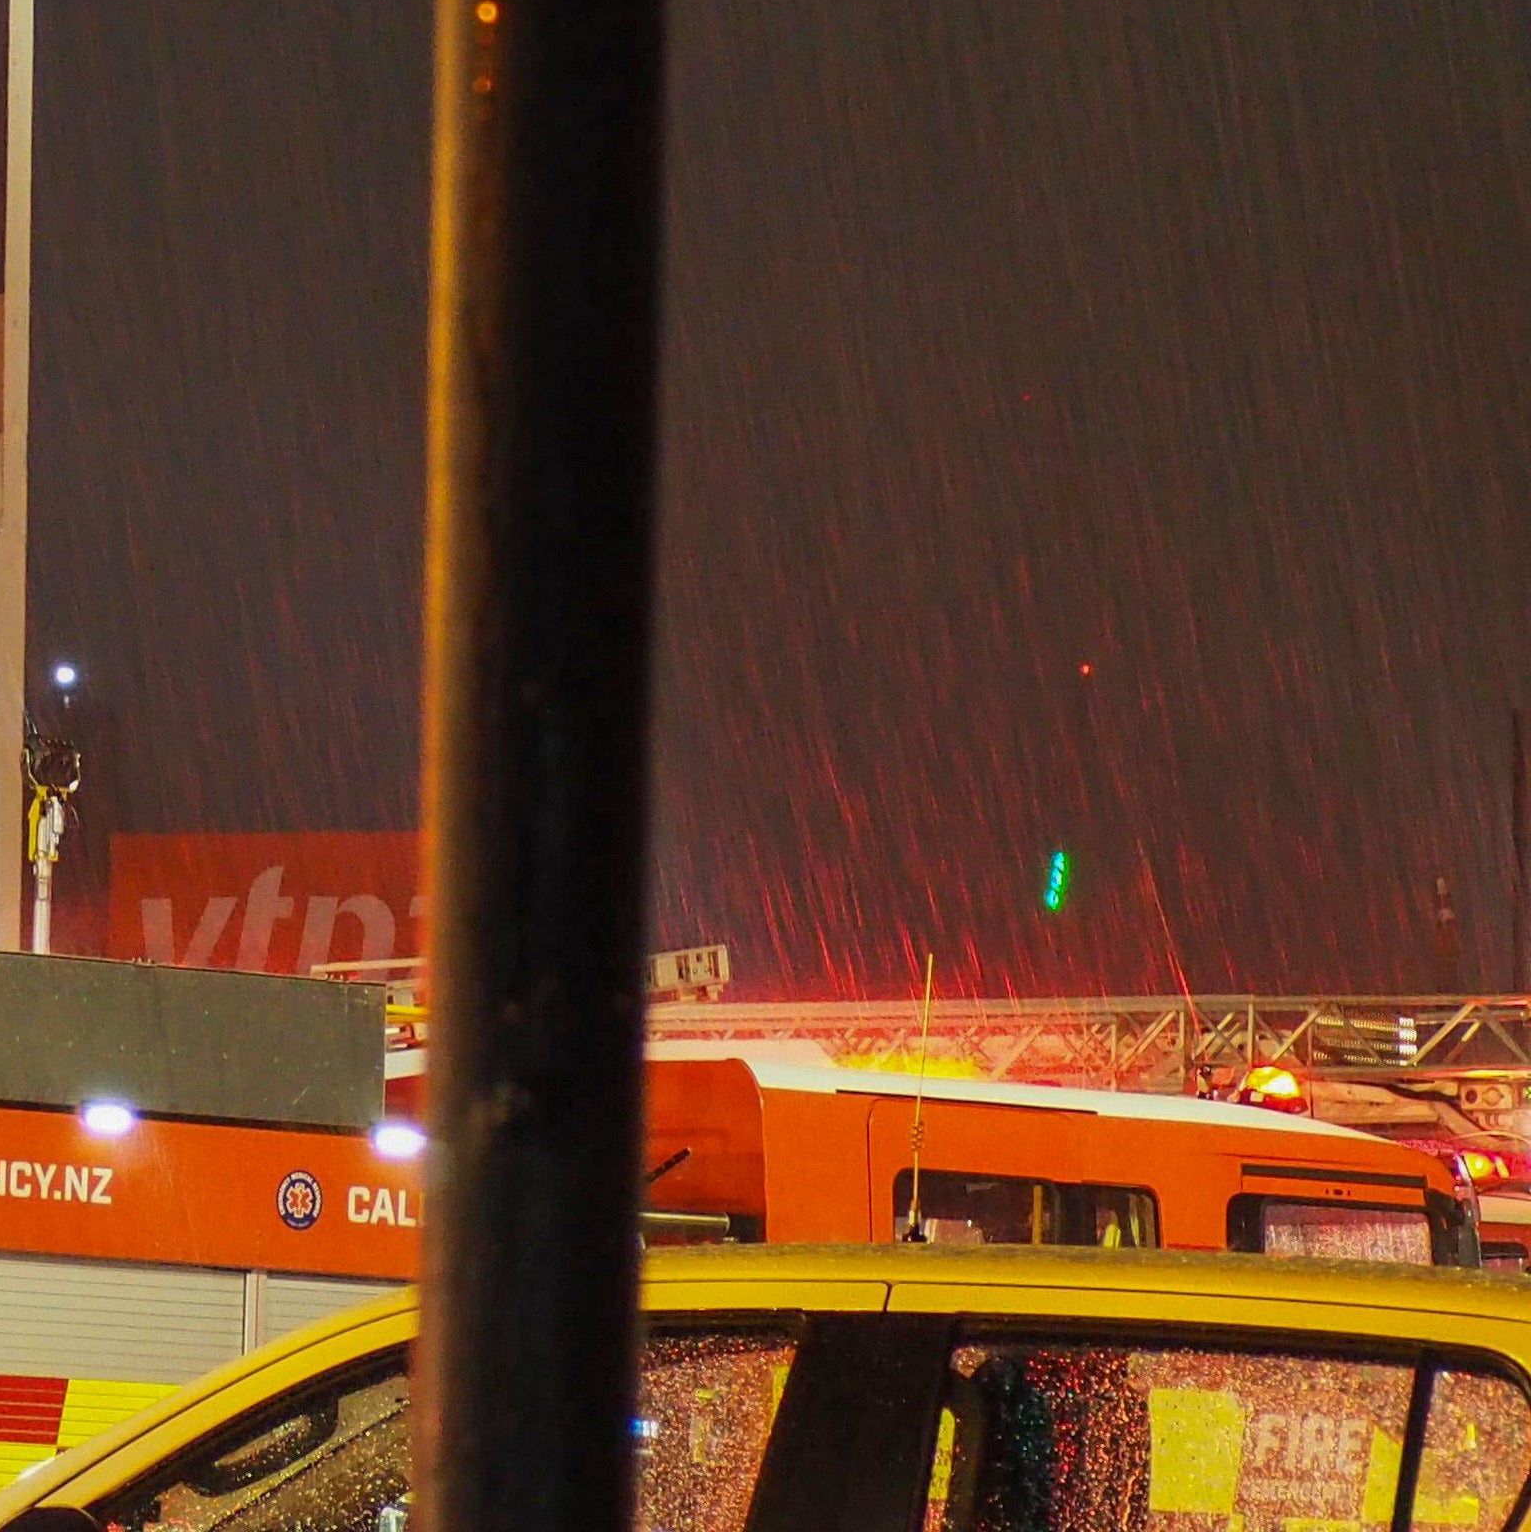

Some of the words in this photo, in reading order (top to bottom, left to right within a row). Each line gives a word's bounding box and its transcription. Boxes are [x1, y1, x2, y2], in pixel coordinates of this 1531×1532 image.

[141, 865, 429, 982] vtn
[348, 1176, 425, 1227] CAL
[1255, 1412, 1368, 1472] FIRE
